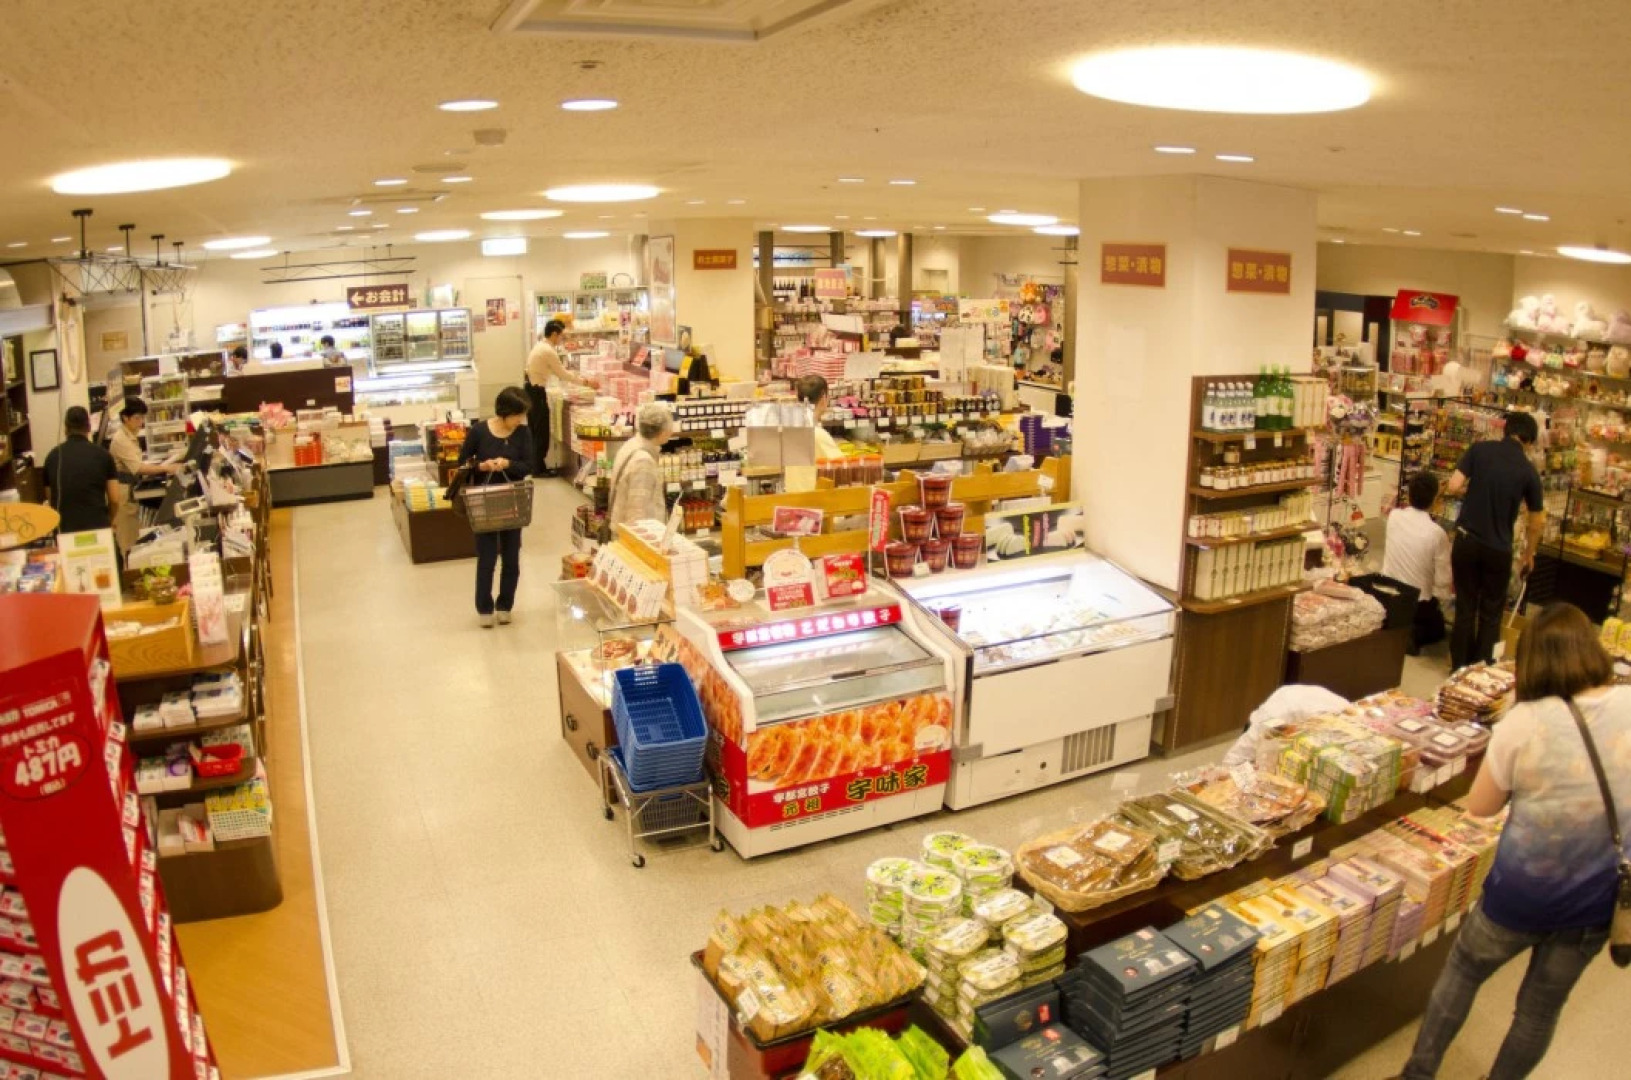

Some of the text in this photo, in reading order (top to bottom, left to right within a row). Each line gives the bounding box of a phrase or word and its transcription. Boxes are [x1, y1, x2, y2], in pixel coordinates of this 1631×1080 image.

[365, 289, 405, 304] お会計
[23, 735, 60, 760] トミカ
[15, 741, 82, 787] 487円
[773, 783, 831, 804] 宇都宮餃子
[74, 928, 154, 1061] トミカ
